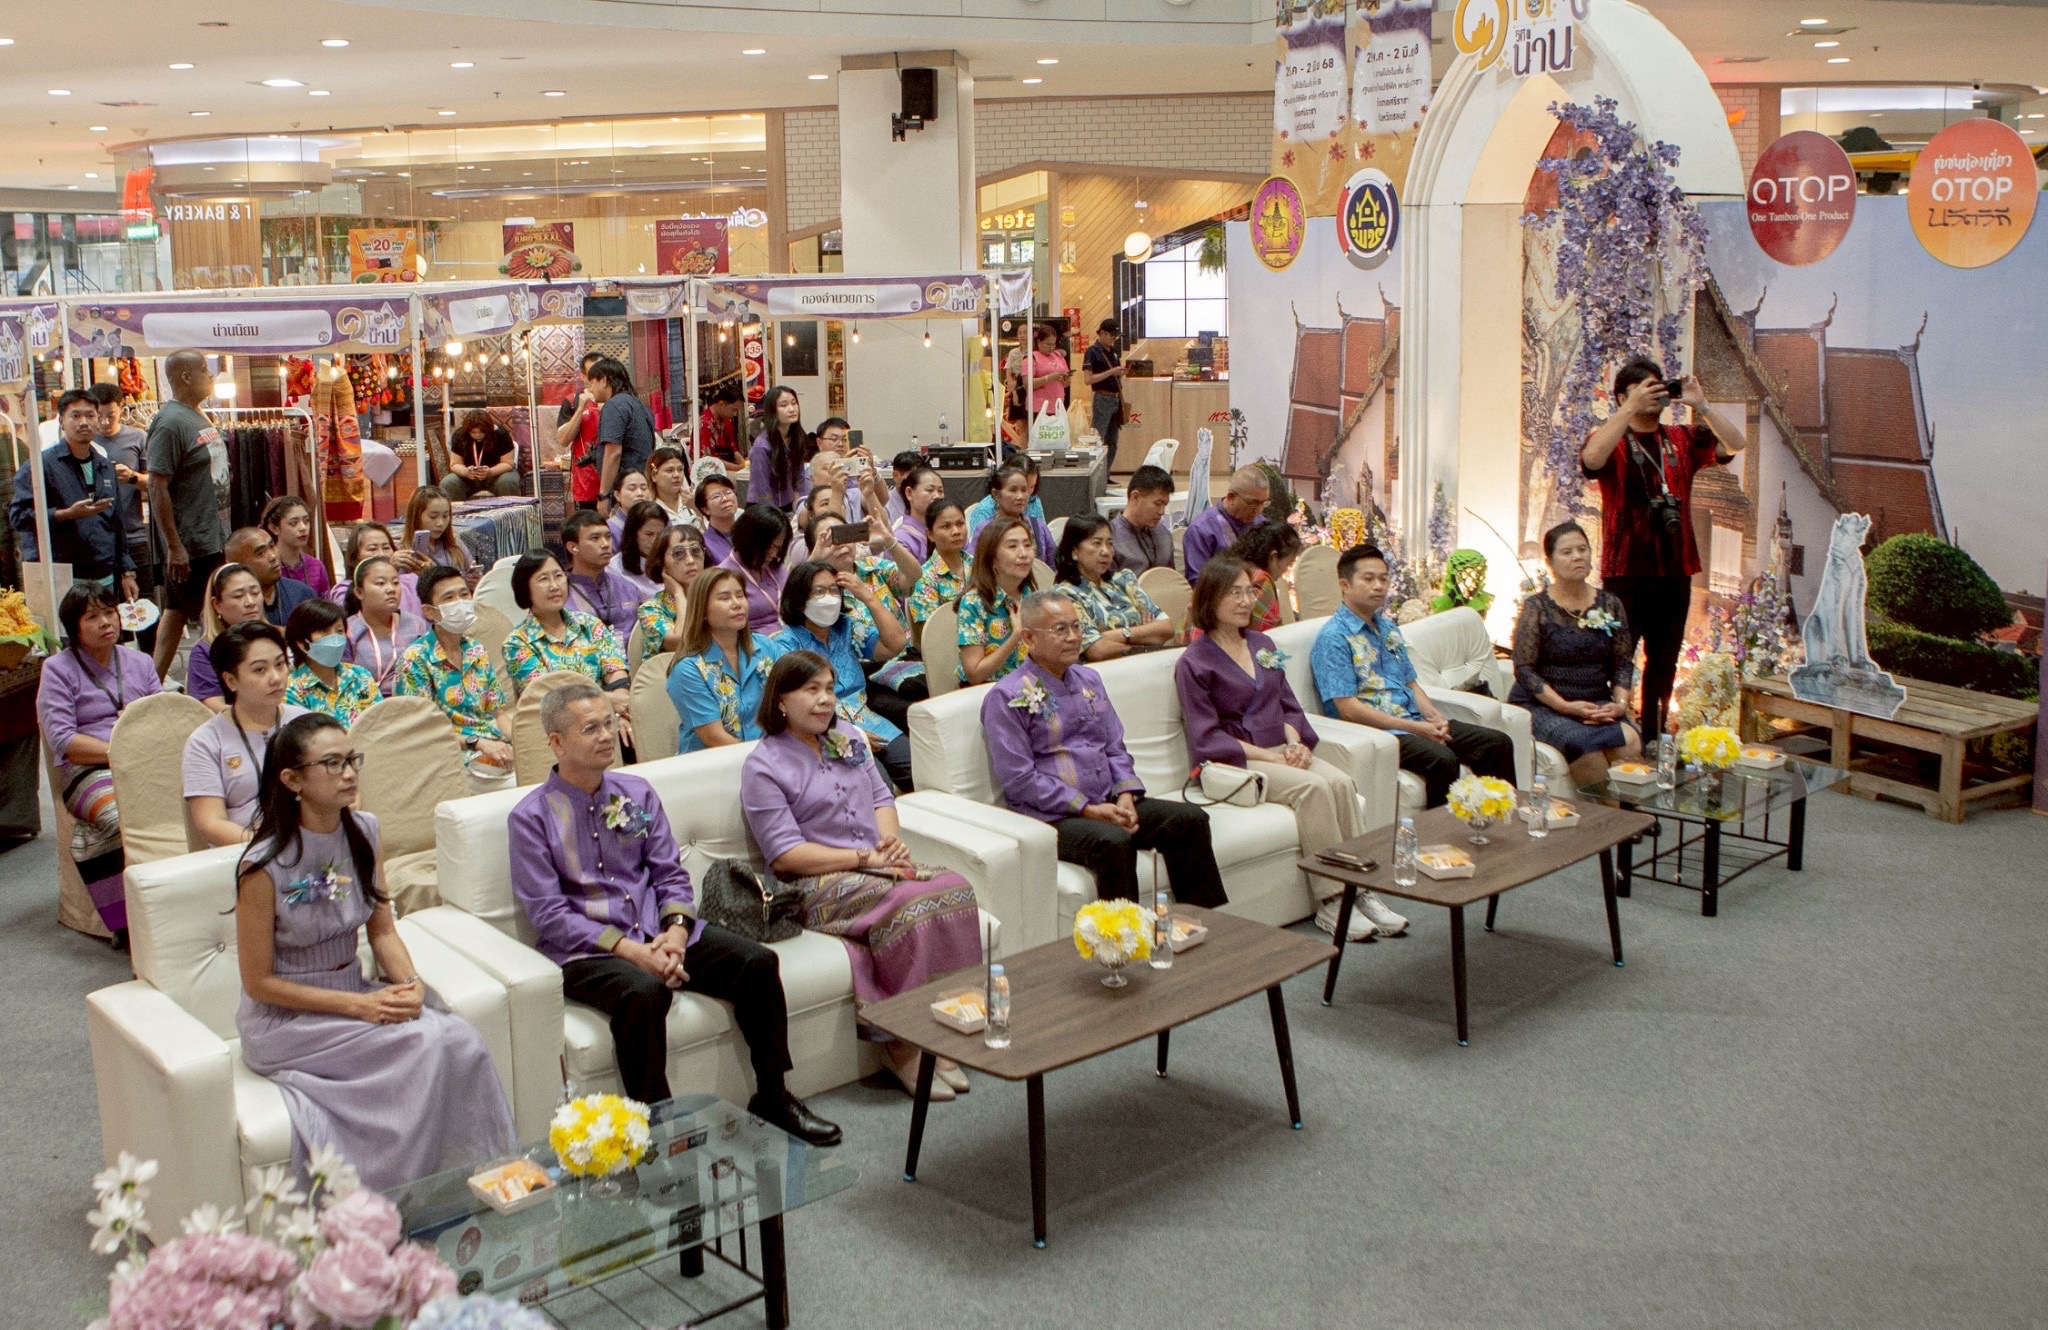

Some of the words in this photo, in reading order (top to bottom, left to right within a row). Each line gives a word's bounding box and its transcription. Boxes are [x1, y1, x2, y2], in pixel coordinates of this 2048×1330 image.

[1513, 25, 1572, 76] น่าน
[1752, 174, 1851, 205] OTOP
[1931, 176, 2013, 202] OTOP
[1751, 212, 1767, 222] One
[1769, 211, 1799, 222] Tambon
[1801, 210, 1817, 221] One
[1819, 210, 1849, 221] Product
[373, 239, 391, 251] 20
[801, 292, 875, 304] กองอำนวยการ
[213, 323, 259, 337] น่านนิยม
[1207, 411, 1230, 422] MK
[1038, 430, 1065, 440] SHOP
